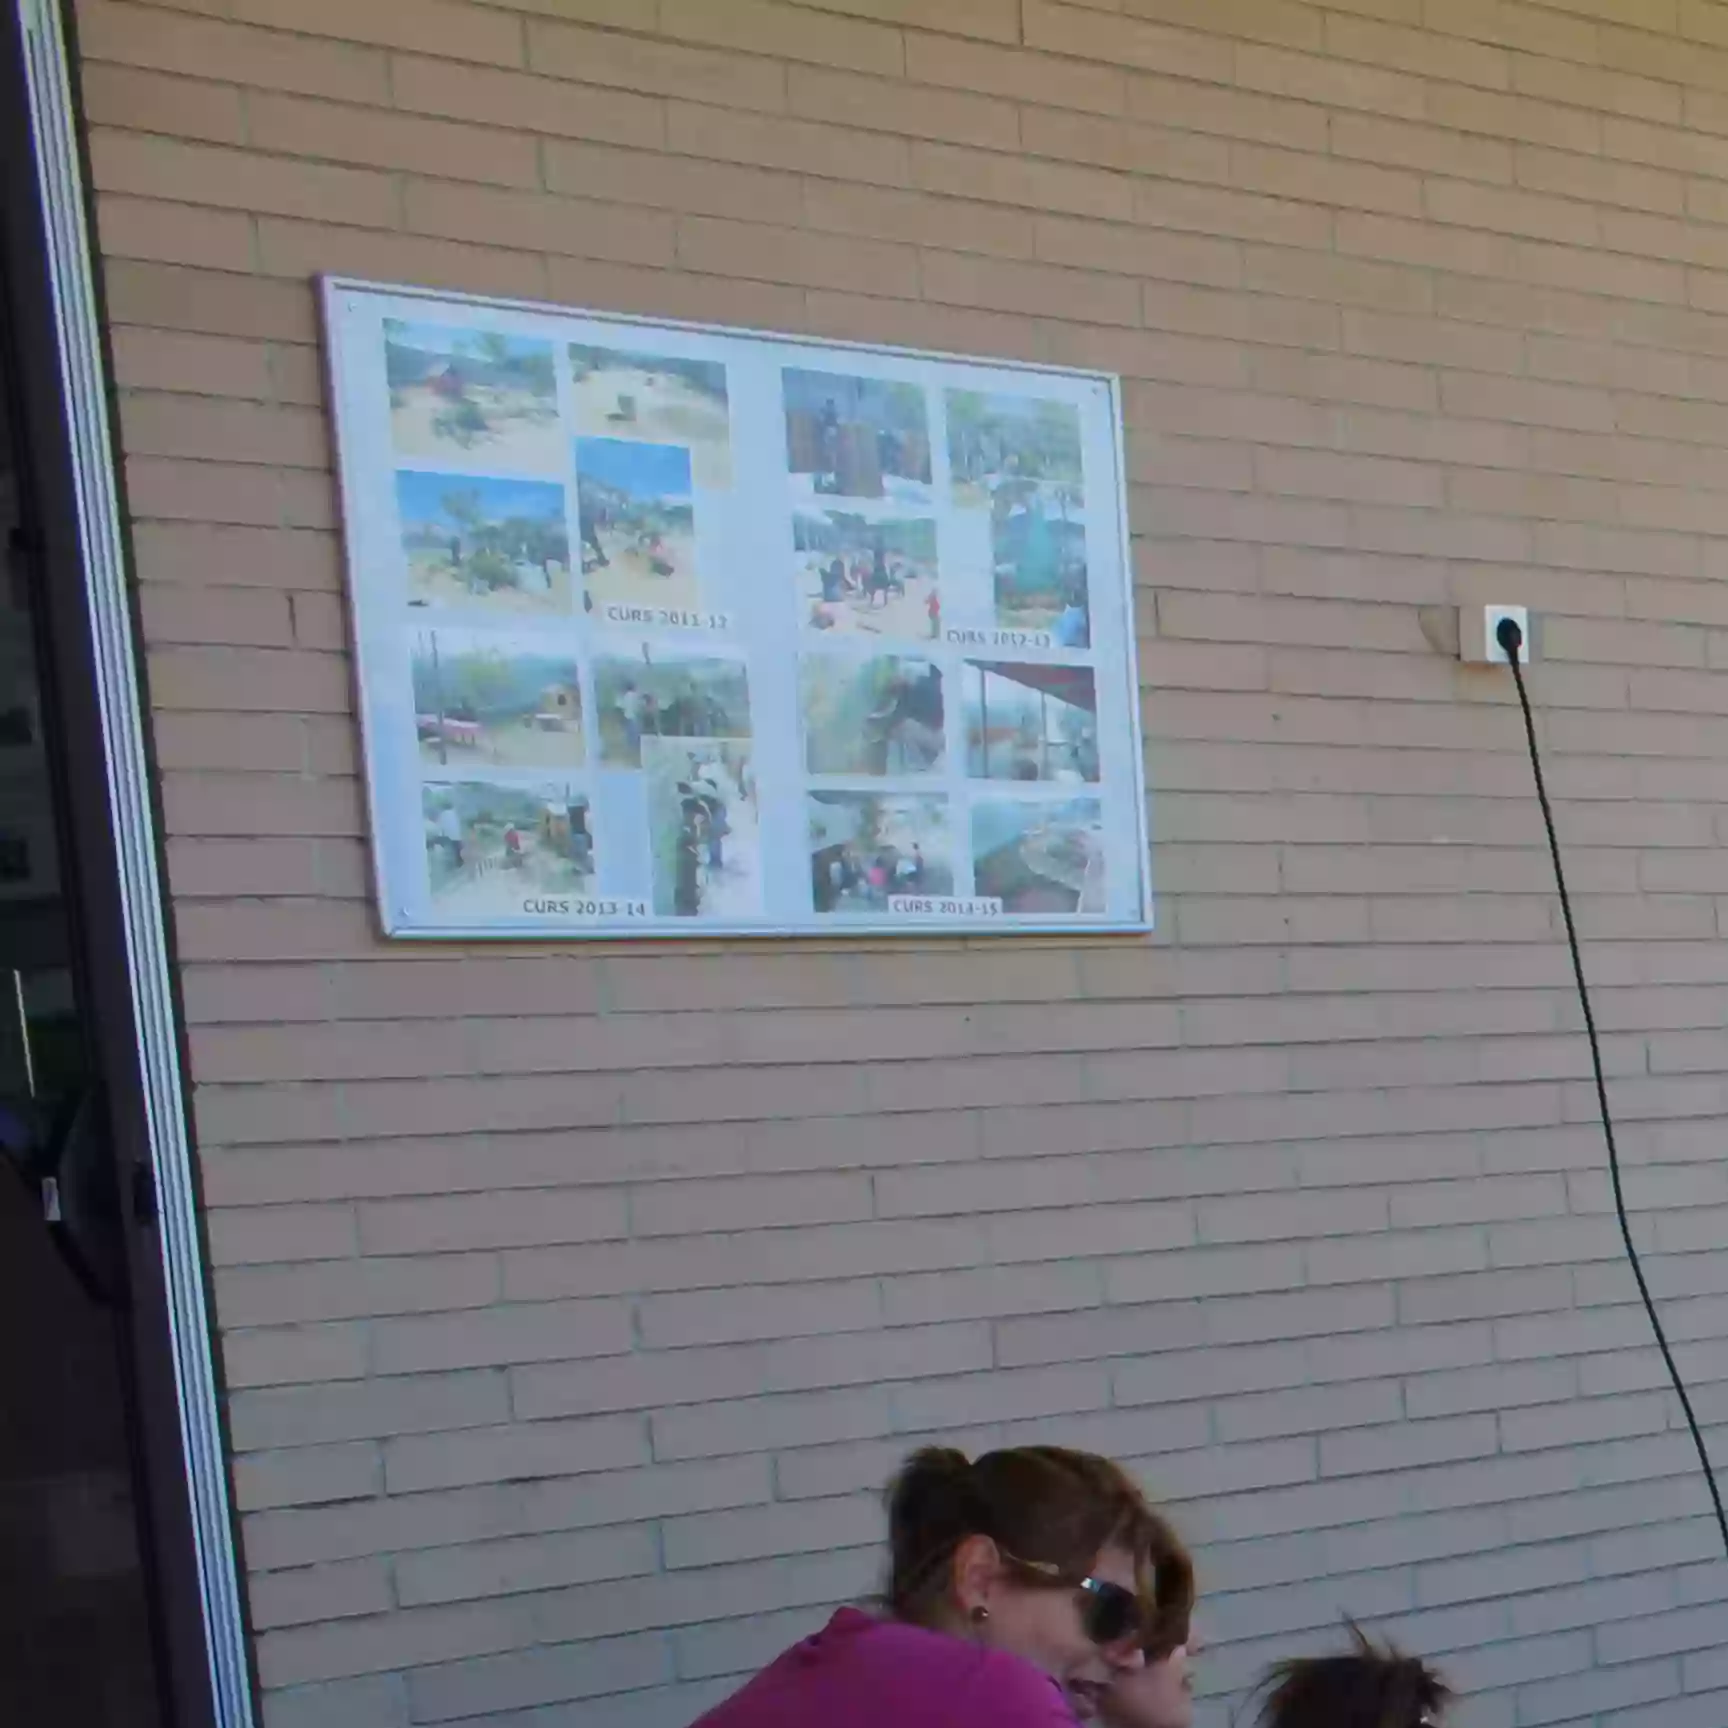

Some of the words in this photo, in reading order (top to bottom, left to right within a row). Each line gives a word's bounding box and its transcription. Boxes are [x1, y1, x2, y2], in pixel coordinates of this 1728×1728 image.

[607, 605, 652, 621] CURS
[523, 899, 569, 914] CURS
[893, 899, 932, 913] CURS
